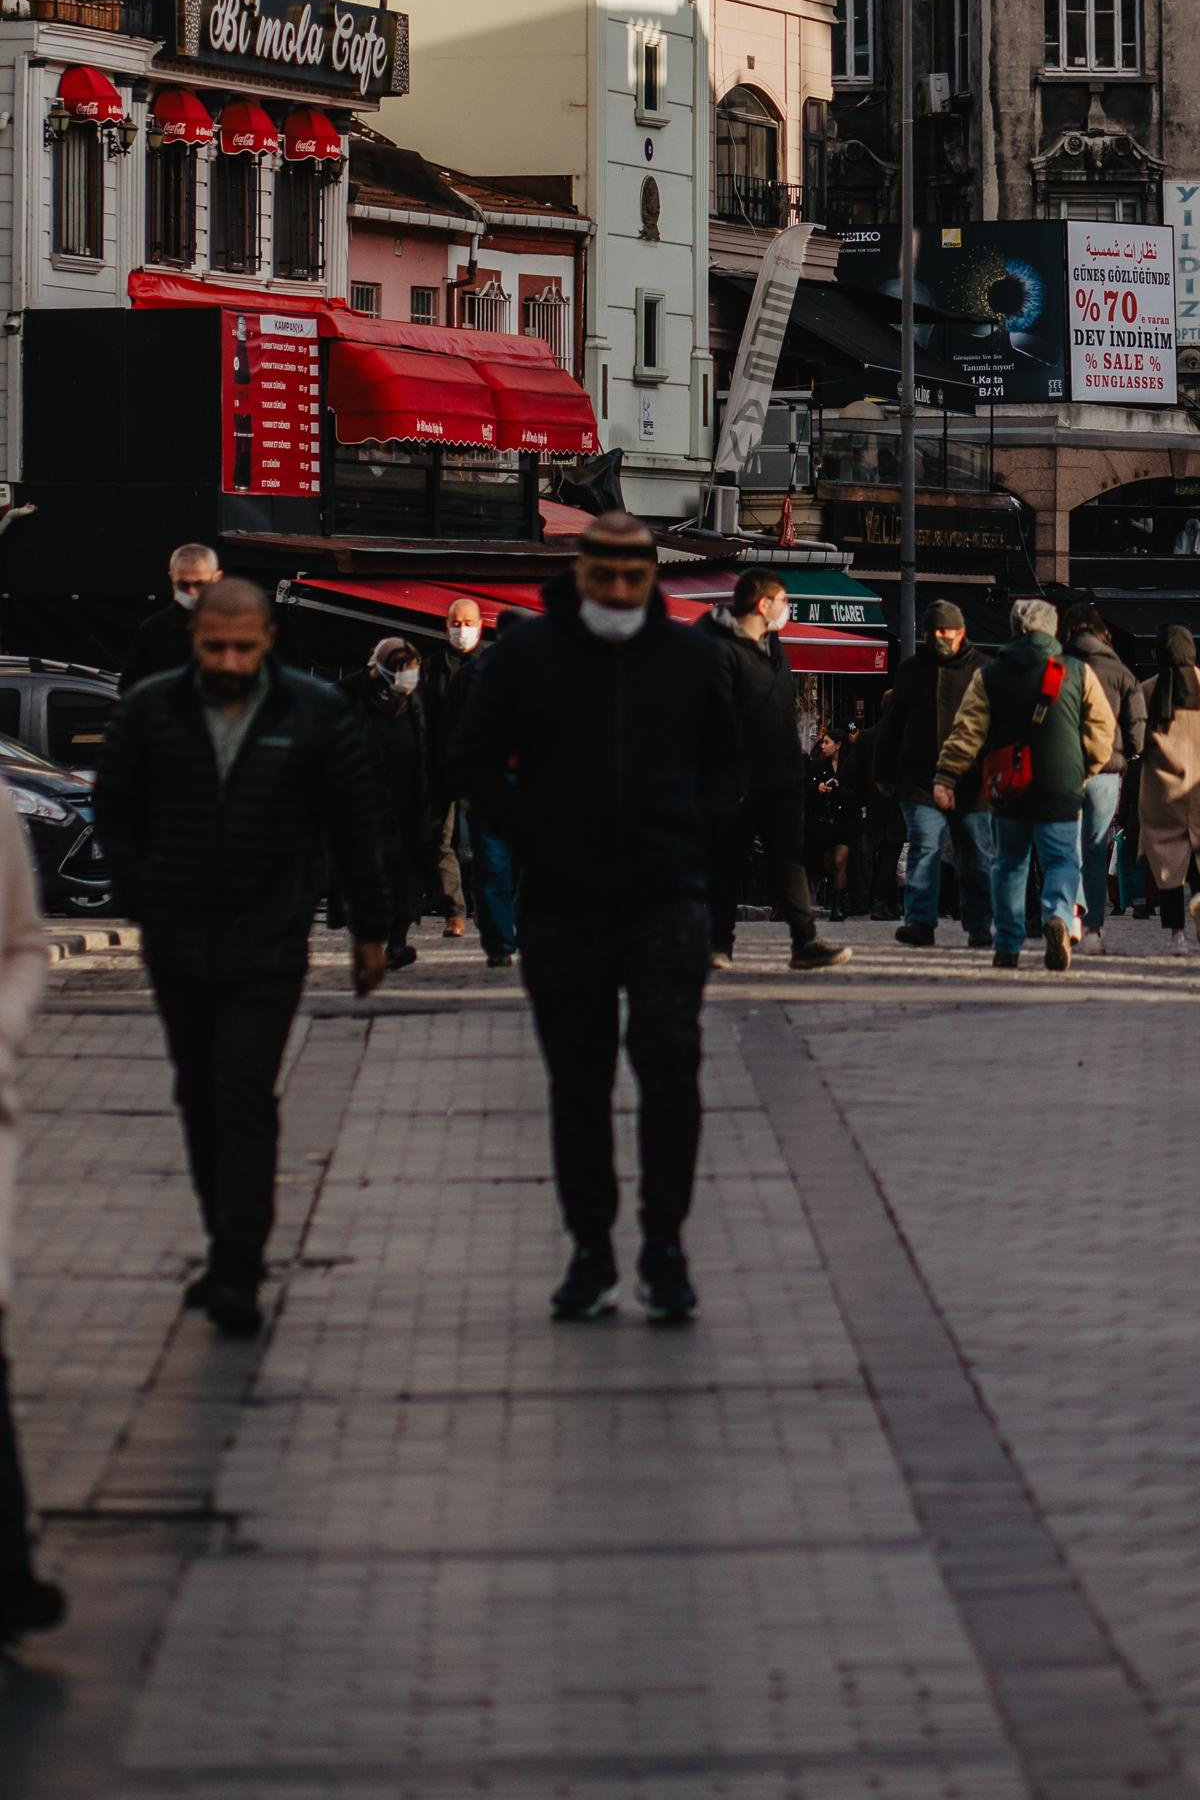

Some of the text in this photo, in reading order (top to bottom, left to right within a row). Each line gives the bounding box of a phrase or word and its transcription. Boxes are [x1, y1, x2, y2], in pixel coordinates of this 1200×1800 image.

[332, 3, 387, 95] Cafe
[837, 231, 881, 242] EIKO
[1086, 235, 1157, 264] نظارات شمسية
[1073, 264, 1170, 286] GÜNEŞ GÖZLÜĞÜNDE
[274, 320, 304, 333] KAMPANYA
[1148, 316, 1169, 325] varan
[1073, 325, 1172, 349] DEV İNDİRİM
[1103, 352, 1144, 370] SALE
[971, 375, 1003, 384] 1.Kata
[1085, 374, 1164, 390] SUNGLASSES
[913, 384, 931, 403] ALİDE
[809, 603, 820, 621] AV
[831, 602, 866, 622] TİCARET
